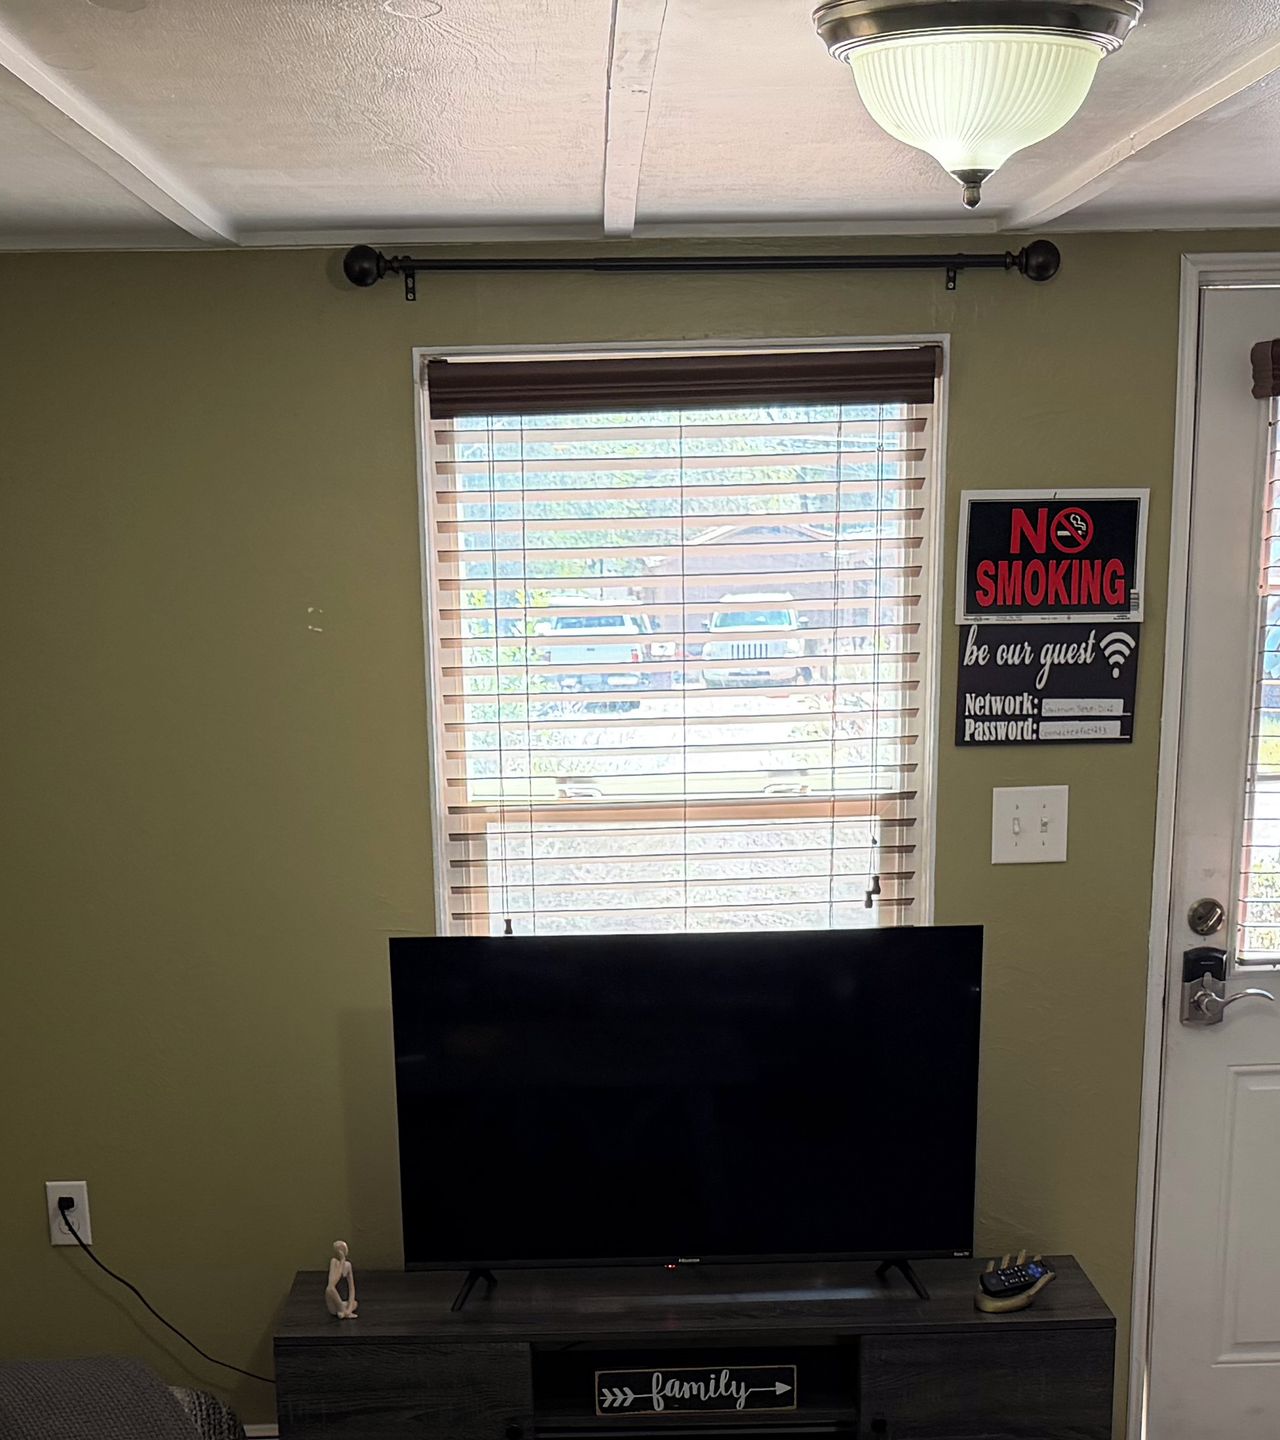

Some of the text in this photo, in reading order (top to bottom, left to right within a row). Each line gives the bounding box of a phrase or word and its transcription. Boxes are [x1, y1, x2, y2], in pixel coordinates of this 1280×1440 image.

[975, 558, 1126, 607] SMOKING
[963, 624, 1096, 690] be our guest
[964, 692, 1039, 717] Network:
[963, 717, 1038, 742] Password:
[651, 1369, 751, 1412] family
